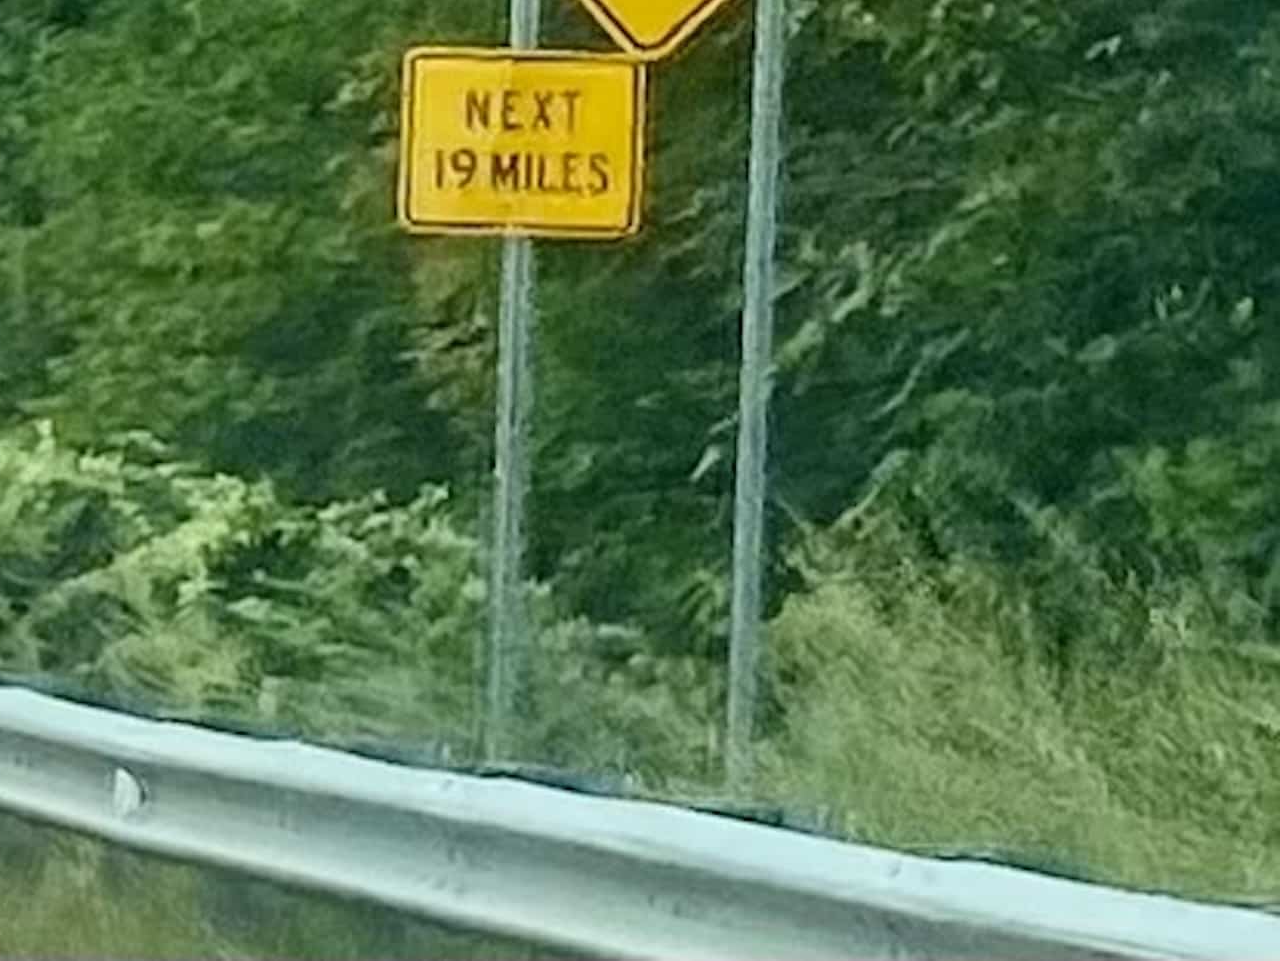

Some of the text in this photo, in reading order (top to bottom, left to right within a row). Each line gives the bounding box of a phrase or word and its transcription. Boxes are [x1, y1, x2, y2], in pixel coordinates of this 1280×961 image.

[465, 90, 582, 134] NEXT
[434, 149, 610, 197] 19 MILES
